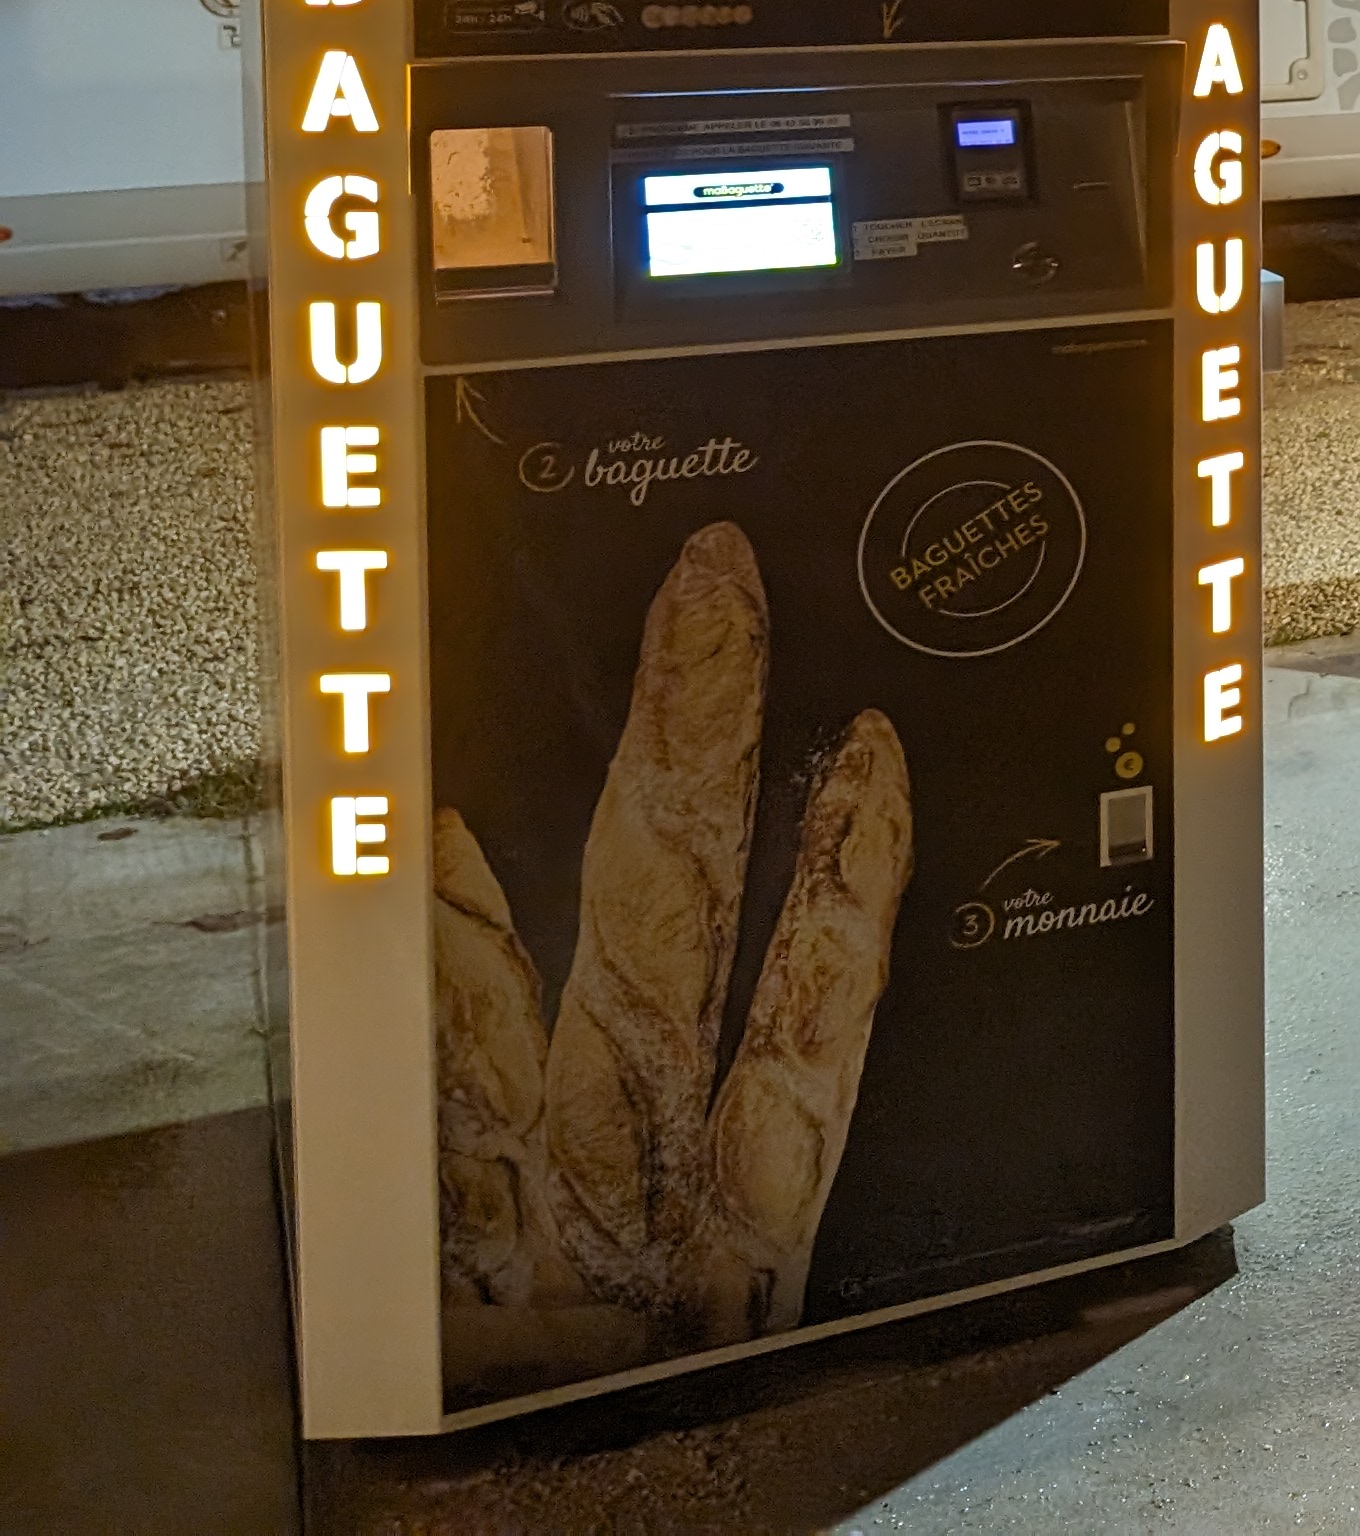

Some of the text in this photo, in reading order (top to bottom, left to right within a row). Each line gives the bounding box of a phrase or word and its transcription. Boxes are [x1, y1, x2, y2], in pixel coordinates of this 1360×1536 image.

[584, 437, 759, 505] baguette
[607, 434, 664, 454] votre
[889, 481, 1045, 593] BAGUETTES
[917, 513, 1051, 613] FRAÎCHES
[1002, 887, 1154, 940] monnaie
[1004, 891, 1053, 913] votre
